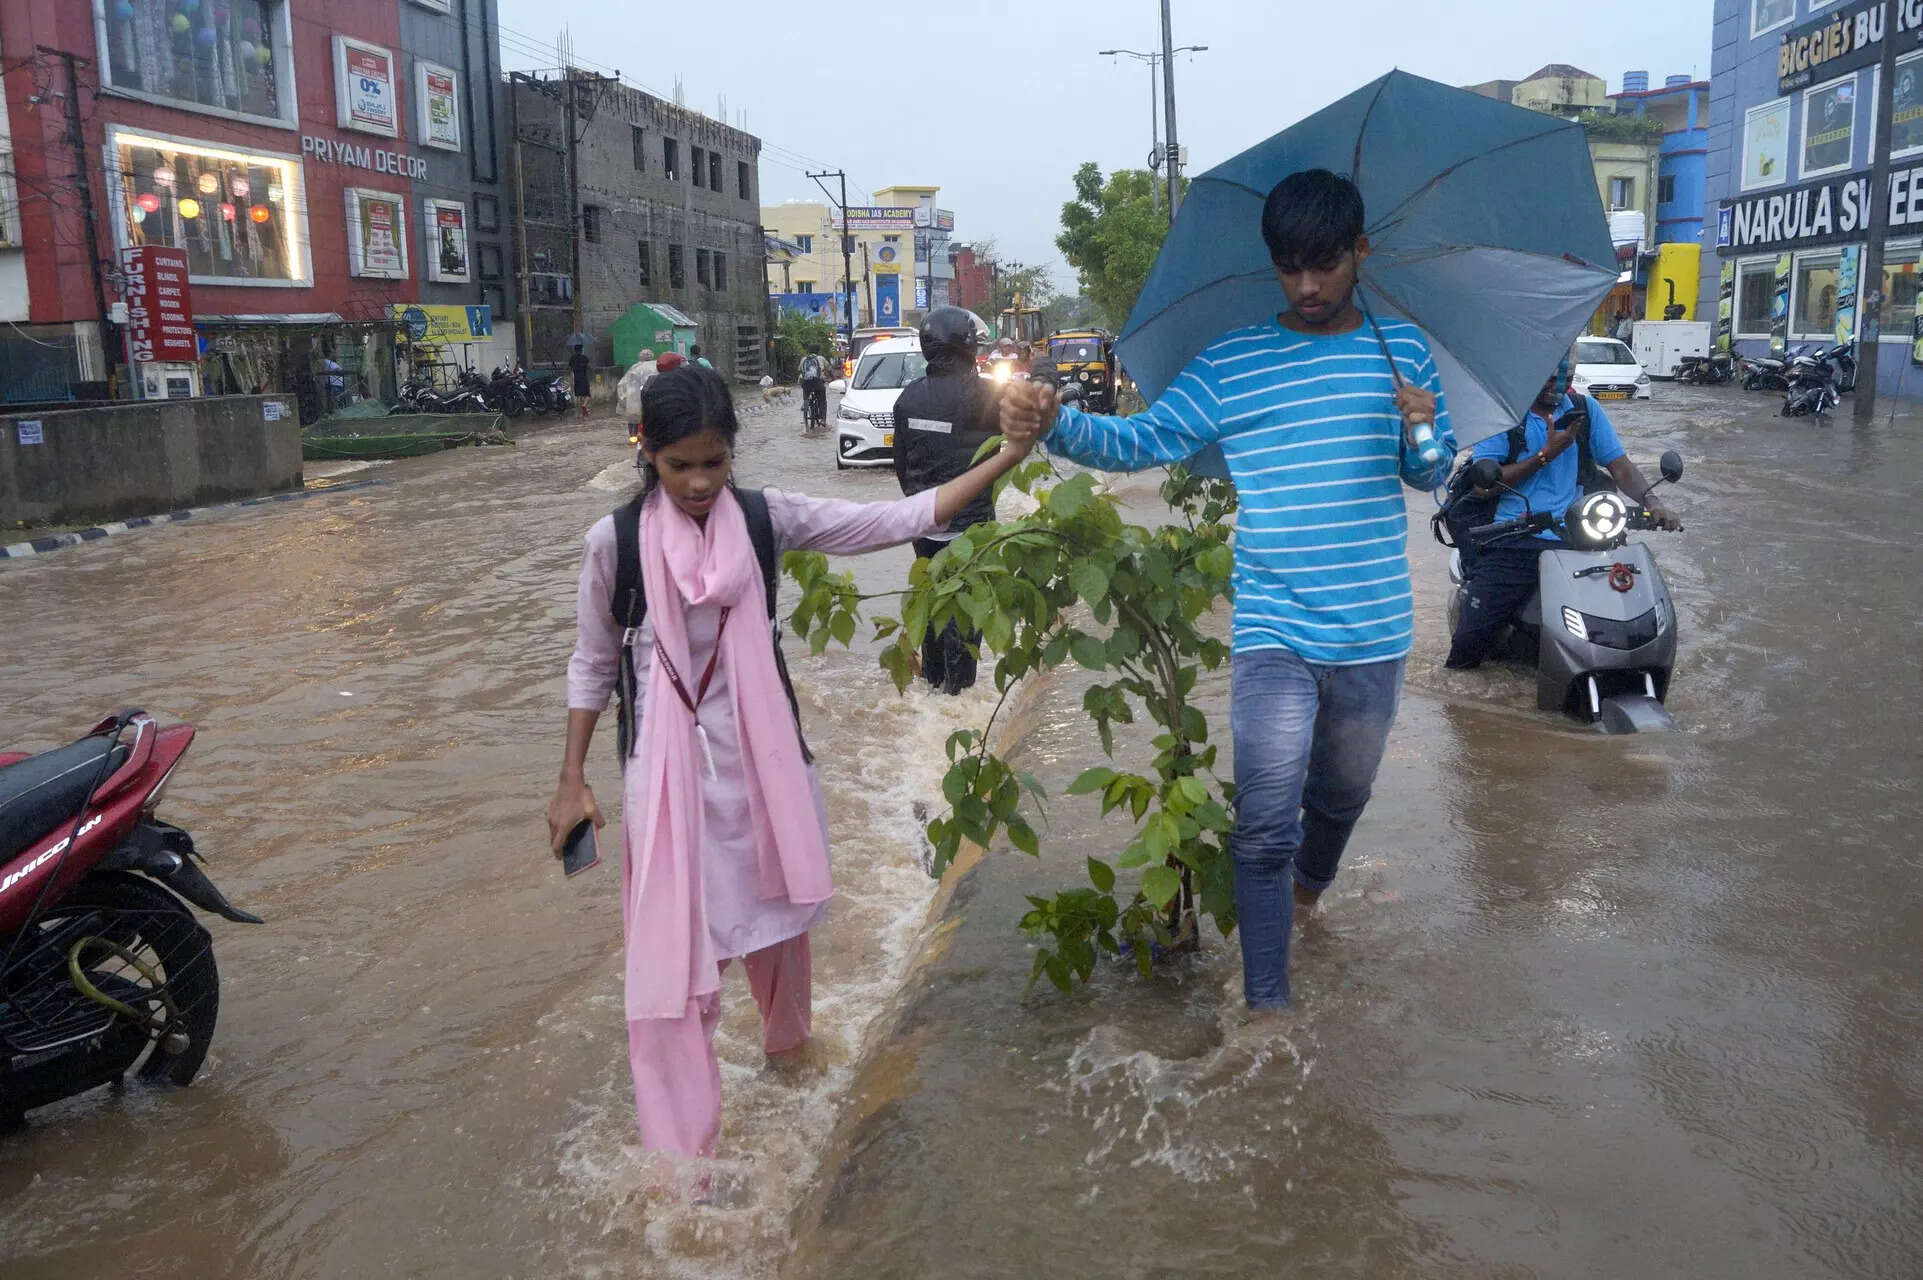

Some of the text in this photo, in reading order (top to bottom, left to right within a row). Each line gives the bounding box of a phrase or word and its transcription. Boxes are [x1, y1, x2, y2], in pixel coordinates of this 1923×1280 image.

[301, 135, 427, 180] PRIYAM DECOR
[847, 209, 870, 218] ODISHA
[871, 209, 882, 218] IAS
[883, 209, 913, 218] ACADEMY
[1733, 186, 1833, 247] NARULA
[122, 248, 154, 362] FURNISHING
